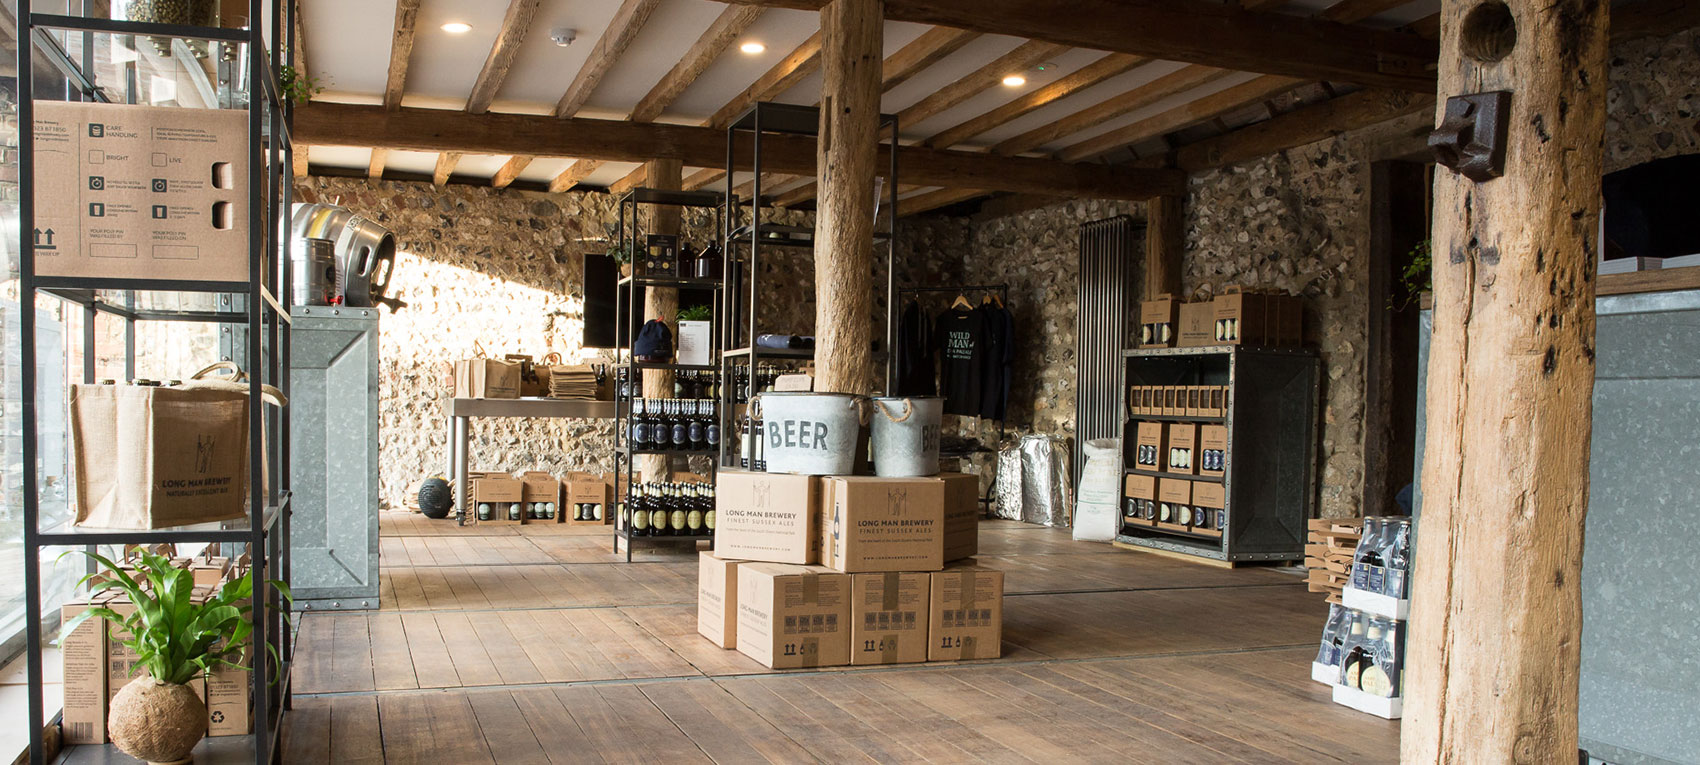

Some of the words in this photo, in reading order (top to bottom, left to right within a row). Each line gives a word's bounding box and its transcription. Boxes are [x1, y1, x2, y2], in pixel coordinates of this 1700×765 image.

[948, 339, 969, 348] MAN
[769, 419, 828, 450] BEER
[162, 480, 186, 488] LONG
[188, 479, 203, 487] MAN
[204, 477, 232, 486] BREWERY
